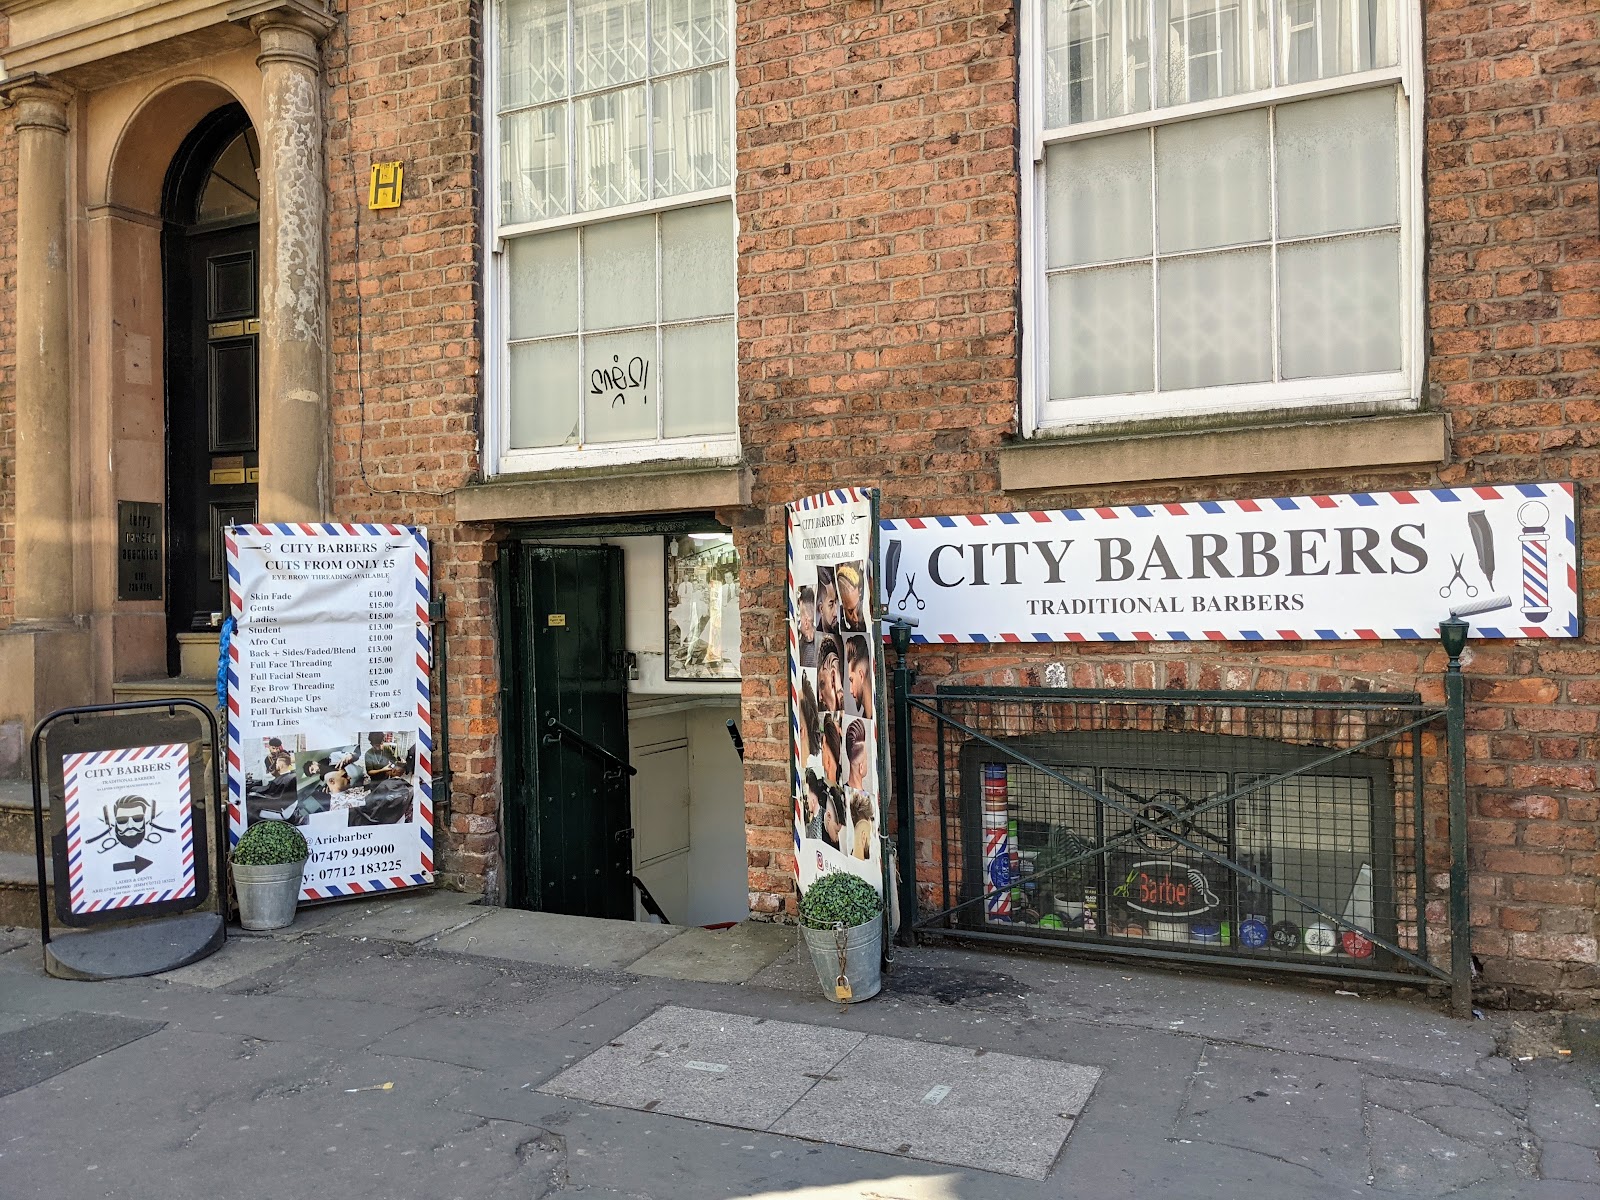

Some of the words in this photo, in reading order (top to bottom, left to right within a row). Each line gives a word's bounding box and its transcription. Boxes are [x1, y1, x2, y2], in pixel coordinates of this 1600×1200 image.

[373, 166, 398, 204] H
[828, 534, 847, 547] ONLY
[849, 533, 860, 545] £5
[280, 543, 314, 554] CITY
[317, 543, 378, 553] BARBERS
[122, 548, 158, 561] agencies
[927, 539, 1076, 588] CITY
[1094, 523, 1429, 583] BARBERS
[265, 560, 300, 570] CUTS
[304, 560, 343, 570] FROM
[346, 560, 380, 570] ONLY
[382, 559, 395, 569] £5
[353, 572, 390, 580] AVAILABLE
[250, 592, 269, 601] Skin
[271, 592, 292, 600] Fade
[368, 590, 394, 598] £10.00
[249, 604, 275, 612] Gents
[368, 601, 394, 609] £15.00
[1026, 596, 1185, 616] TRADITIONAL
[1191, 593, 1305, 613] BARBERS
[249, 615, 278, 623] Ladies
[369, 612, 394, 620] £15.00
[248, 626, 281, 634] Student
[368, 623, 393, 631] £13.00
[248, 638, 269, 646] Afro
[368, 634, 393, 642] £10.00
[249, 649, 270, 657] Back
[282, 646, 356, 656] Sides/Faded/Blend
[367, 645, 392, 653] £13.00
[250, 661, 266, 669] Full
[268, 660, 288, 668] Face
[290, 659, 333, 668] Threading
[369, 656, 394, 664] £15.00
[250, 673, 267, 681] Full
[269, 671, 294, 680] Facial
[296, 671, 321, 679] Steam
[369, 667, 394, 675] £12.00
[369, 678, 390, 687] £5.00
[250, 684, 266, 694] Eye
[268, 684, 290, 692] Brow
[292, 682, 335, 691] Threading
[369, 690, 391, 698] From
[392, 688, 402, 696] £5
[250, 695, 304, 704] Beard/Shape
[305, 694, 322, 703] Ups
[370, 701, 391, 709] £8.00
[250, 707, 268, 716] Full
[270, 706, 302, 715] Turkish
[304, 705, 328, 713] Shave
[370, 712, 392, 720] From
[393, 710, 413, 718] £2.50
[251, 719, 274, 728] Tram
[276, 718, 300, 726] Lines
[84, 768, 114, 779] CITY
[116, 762, 171, 776] BARBERS
[311, 849, 348, 863] 07479
[352, 844, 395, 859] 949900
[319, 866, 356, 880] 07712
[360, 859, 402, 874] 183225
[1140, 873, 1193, 906] Barber
